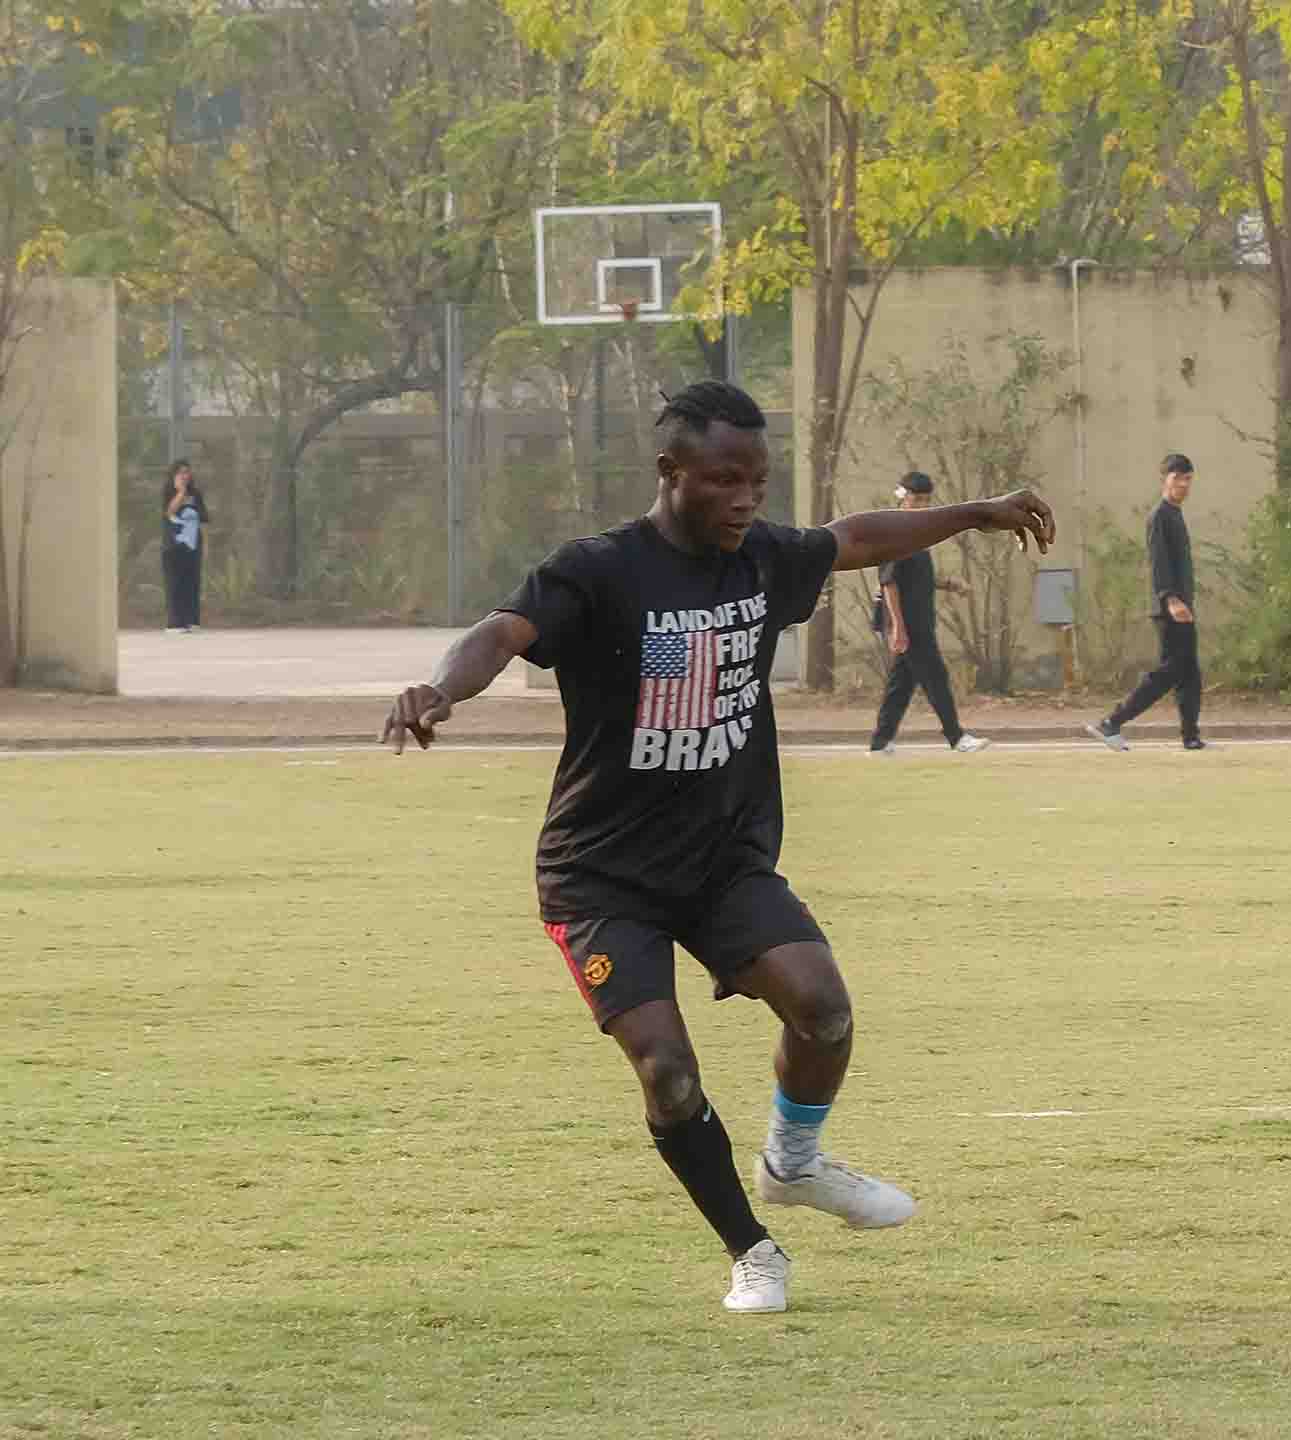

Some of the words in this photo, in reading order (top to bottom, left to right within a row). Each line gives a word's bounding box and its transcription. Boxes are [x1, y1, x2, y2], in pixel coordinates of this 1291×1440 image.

[647, 609, 713, 633] LAND
[713, 602, 737, 628] OF
[713, 693, 738, 719] OF
